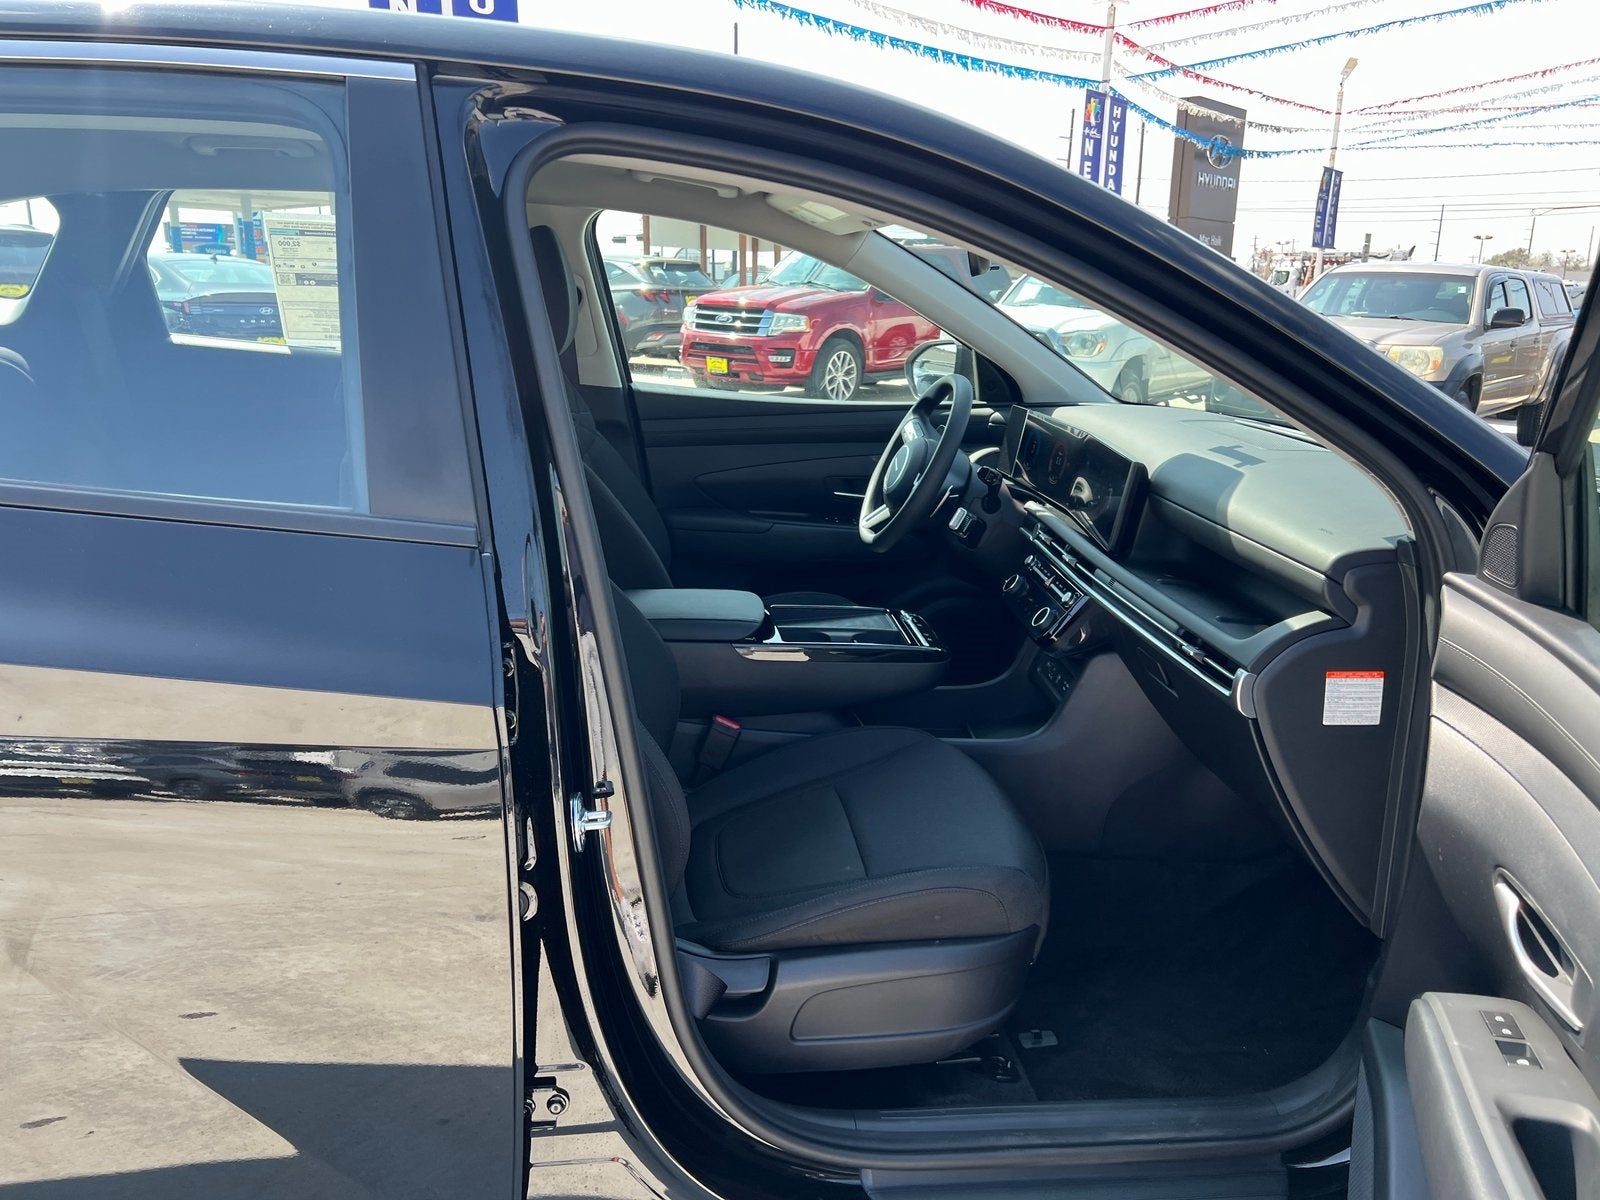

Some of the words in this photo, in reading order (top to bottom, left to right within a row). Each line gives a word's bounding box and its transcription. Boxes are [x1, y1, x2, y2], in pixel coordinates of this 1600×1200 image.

[1083, 138, 1094, 179] NE
[1107, 106, 1122, 191] HYUNDA
[1198, 171, 1236, 189] HYUNDAI
